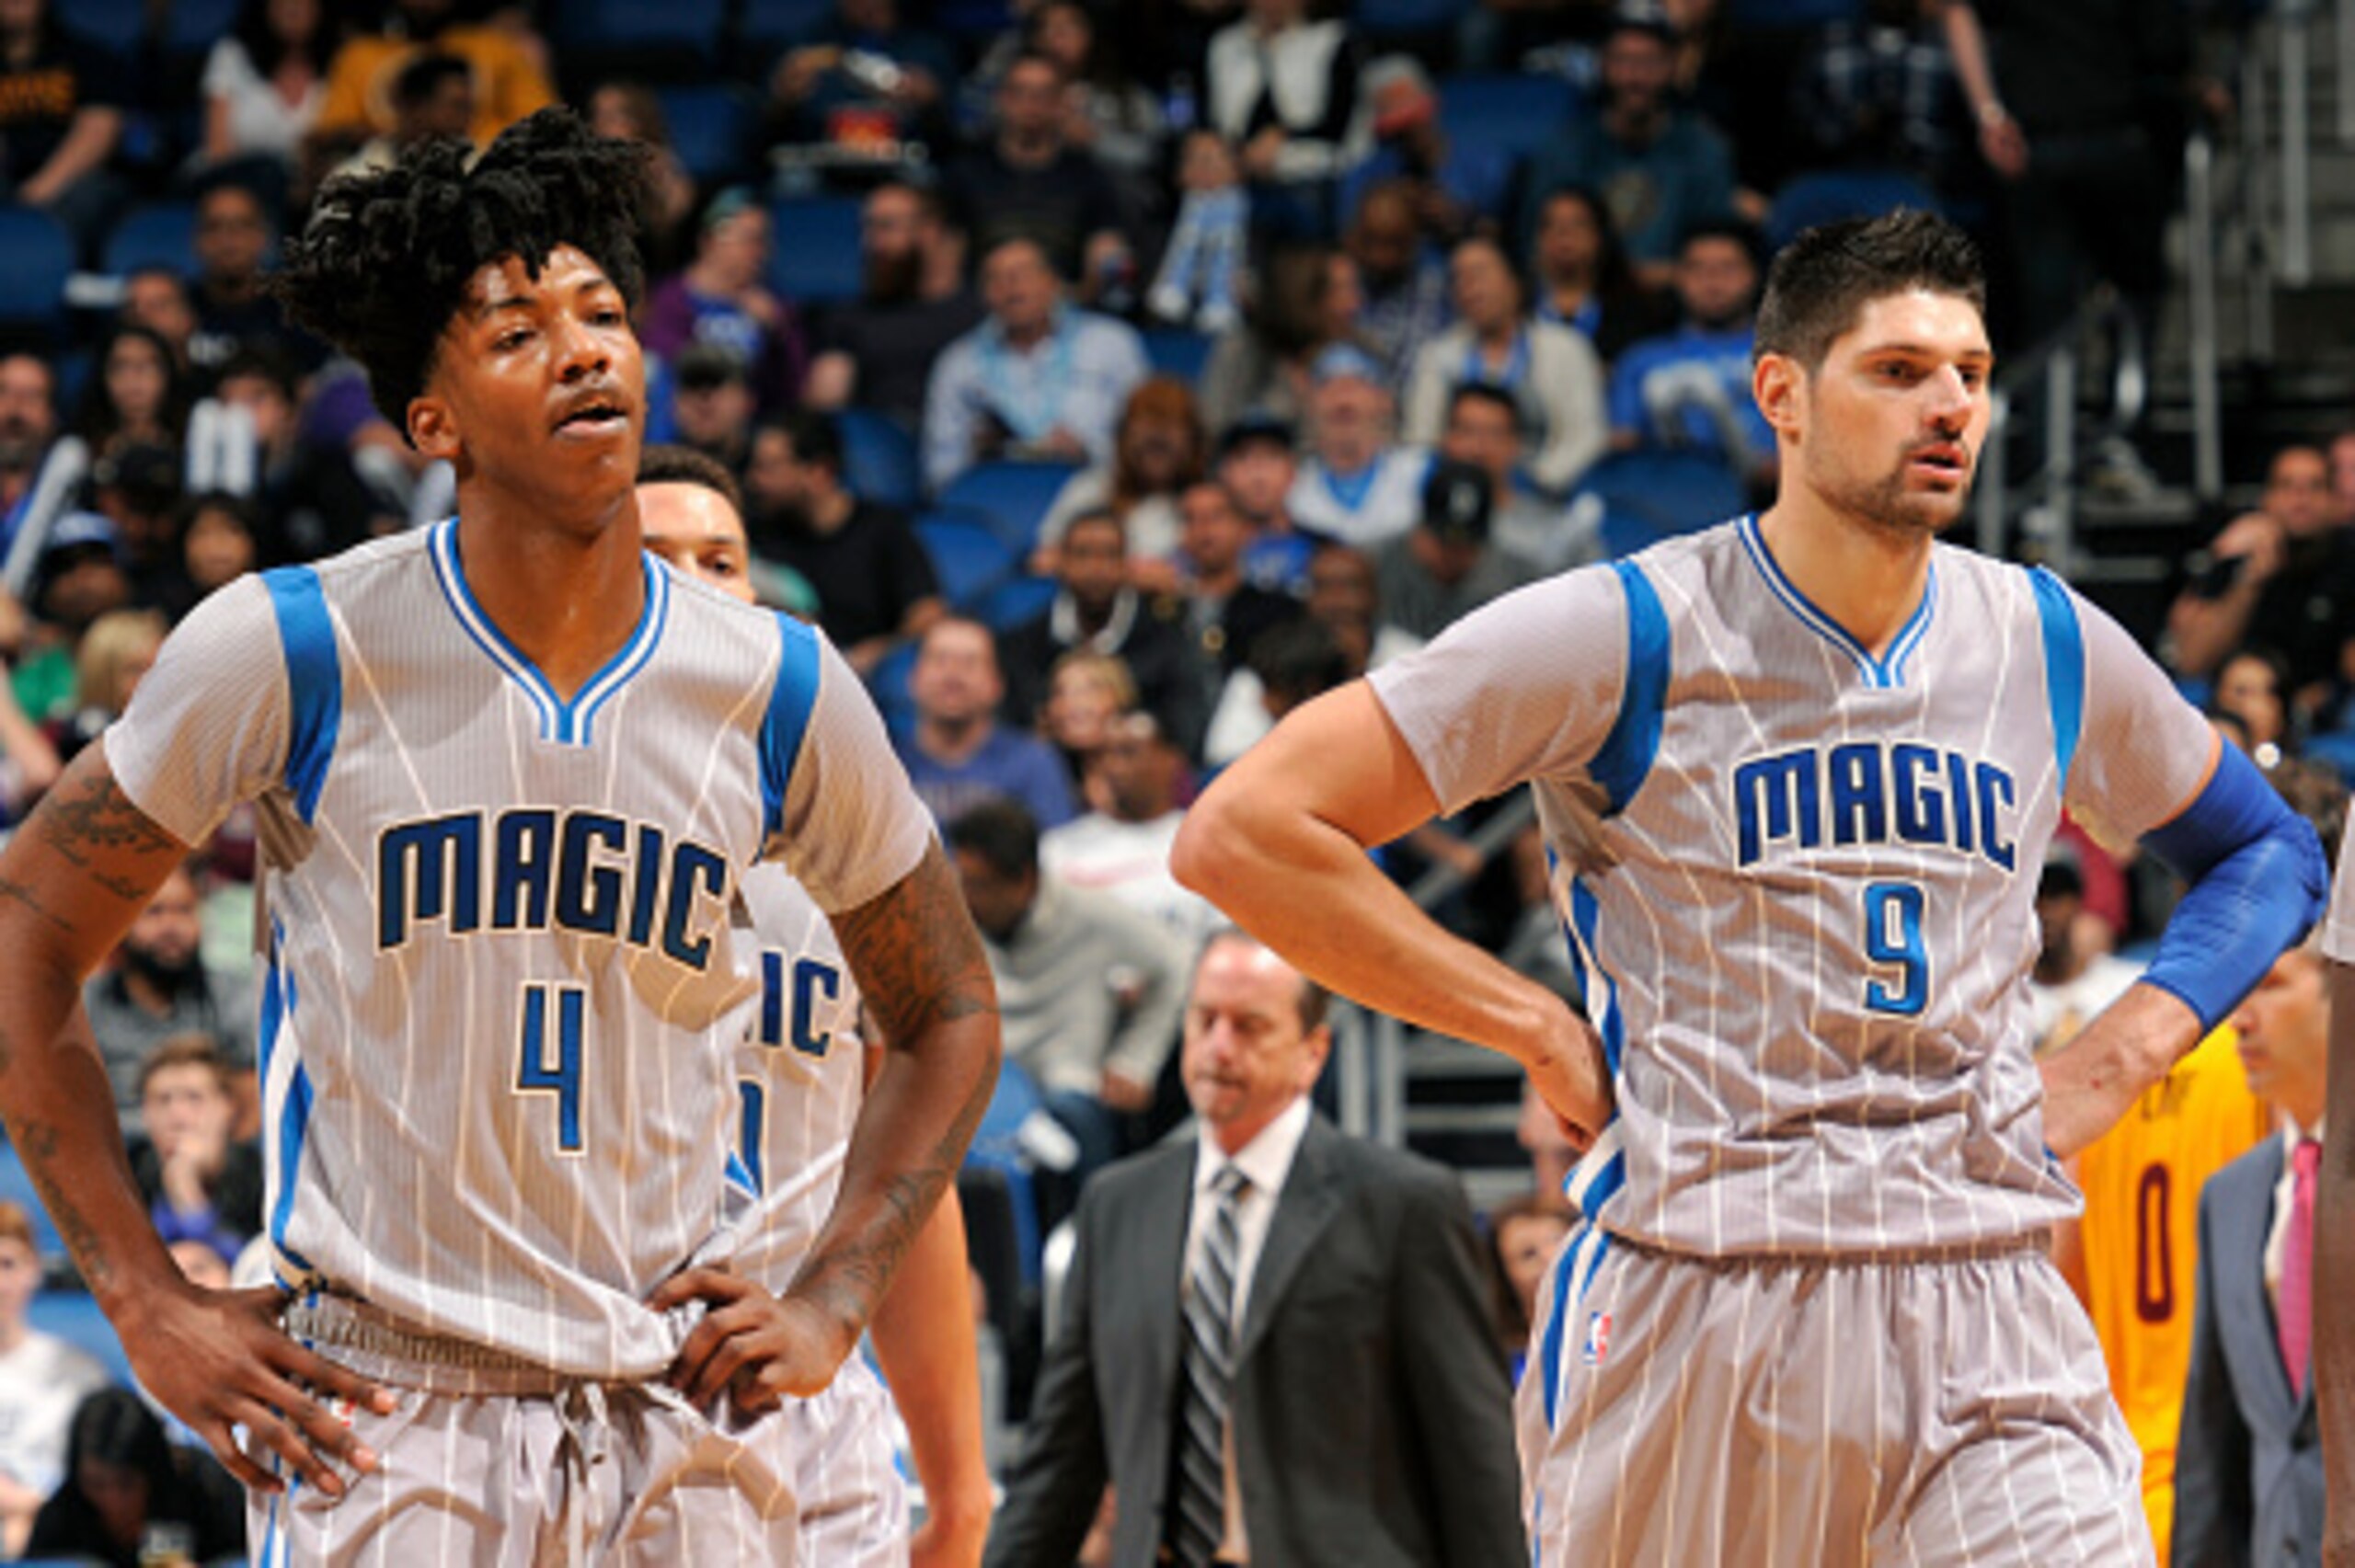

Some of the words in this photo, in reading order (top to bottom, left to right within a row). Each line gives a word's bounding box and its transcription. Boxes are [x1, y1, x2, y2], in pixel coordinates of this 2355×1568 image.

[1732, 742, 2017, 874] MAGIC
[376, 807, 729, 973] MAGIC
[1863, 881, 1930, 1018] 9
[513, 984, 586, 1152] 4
[743, 948, 841, 1059] IC
[2137, 1162, 2174, 1324] 0
